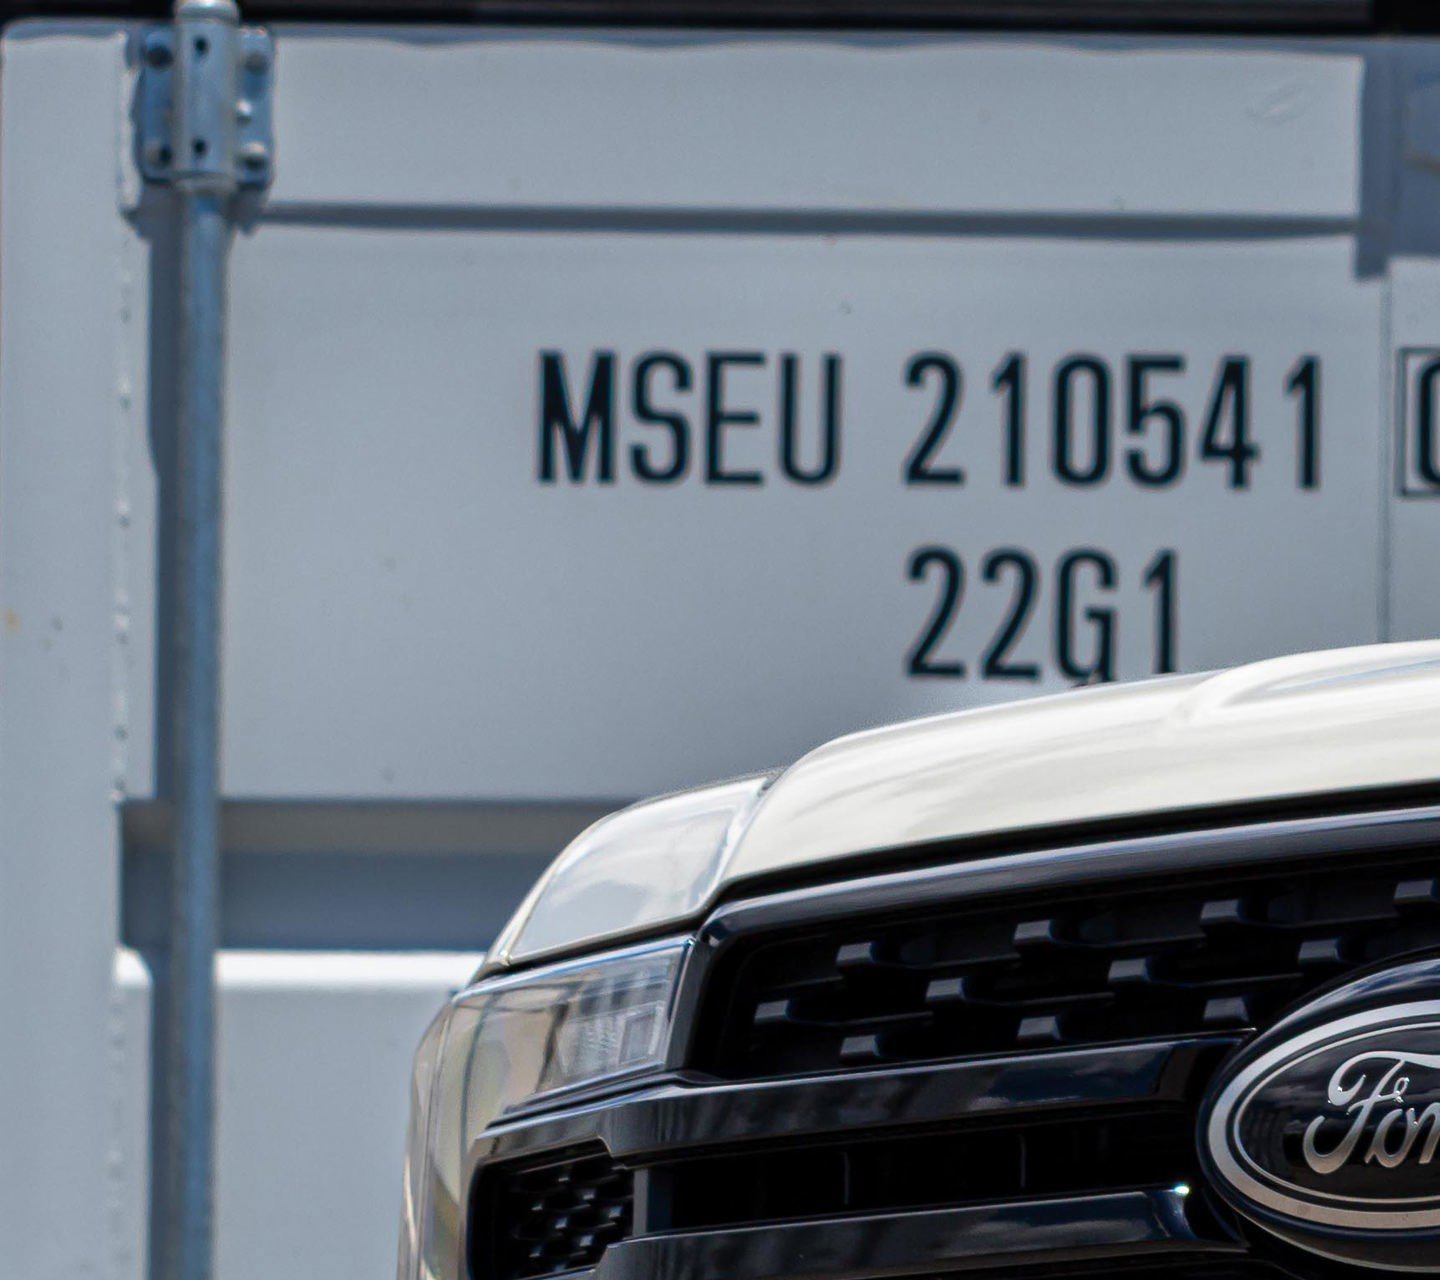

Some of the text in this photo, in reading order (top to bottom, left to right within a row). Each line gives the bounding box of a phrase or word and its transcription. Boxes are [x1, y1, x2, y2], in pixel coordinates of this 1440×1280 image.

[538, 351, 842, 486] MSEU
[904, 352, 1321, 491] 210541
[906, 546, 1178, 687] 22G1
